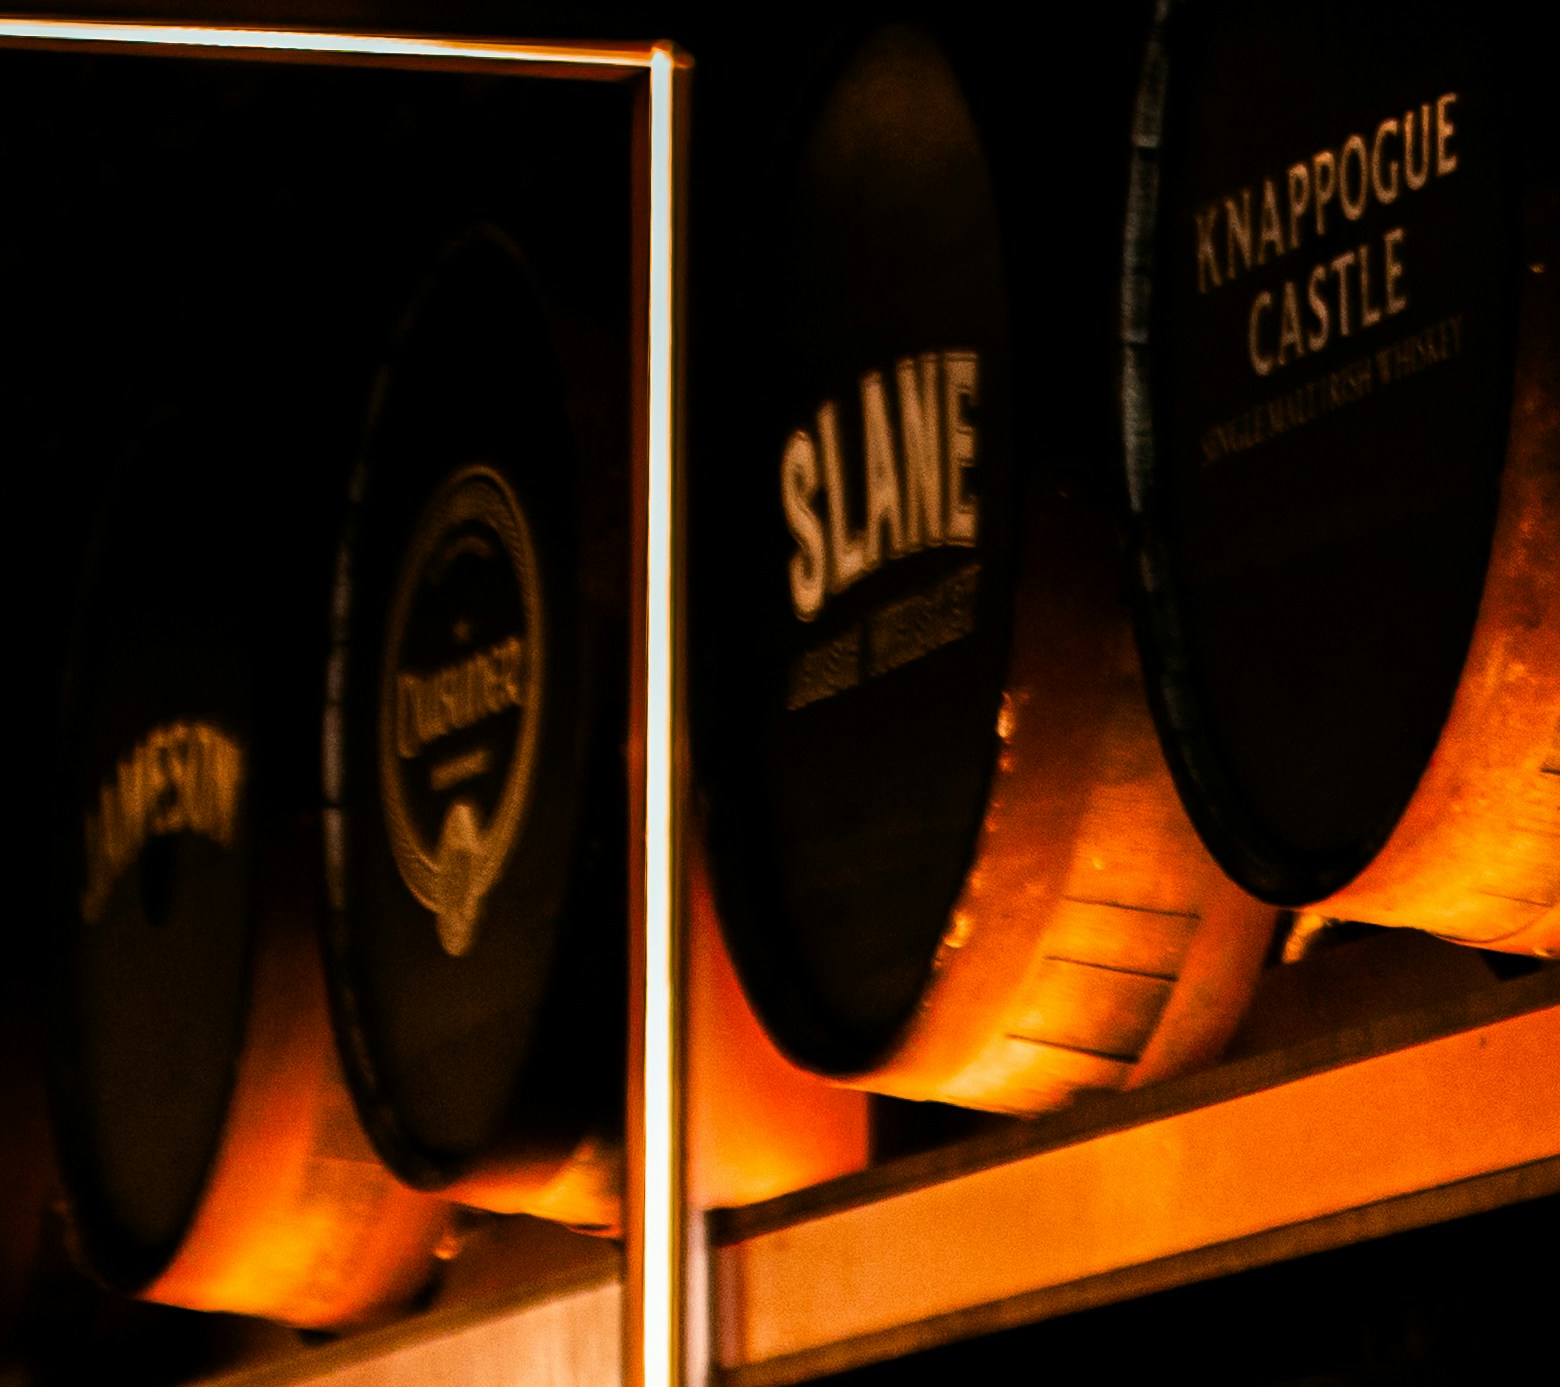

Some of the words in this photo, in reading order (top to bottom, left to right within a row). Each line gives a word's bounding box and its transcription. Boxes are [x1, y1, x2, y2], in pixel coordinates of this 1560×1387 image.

[1193, 91, 1460, 293] KNAPPOGUE
[1248, 227, 1409, 375] CASTLE
[1376, 313, 1463, 386] WHISKEY
[779, 348, 983, 623] SLANE
